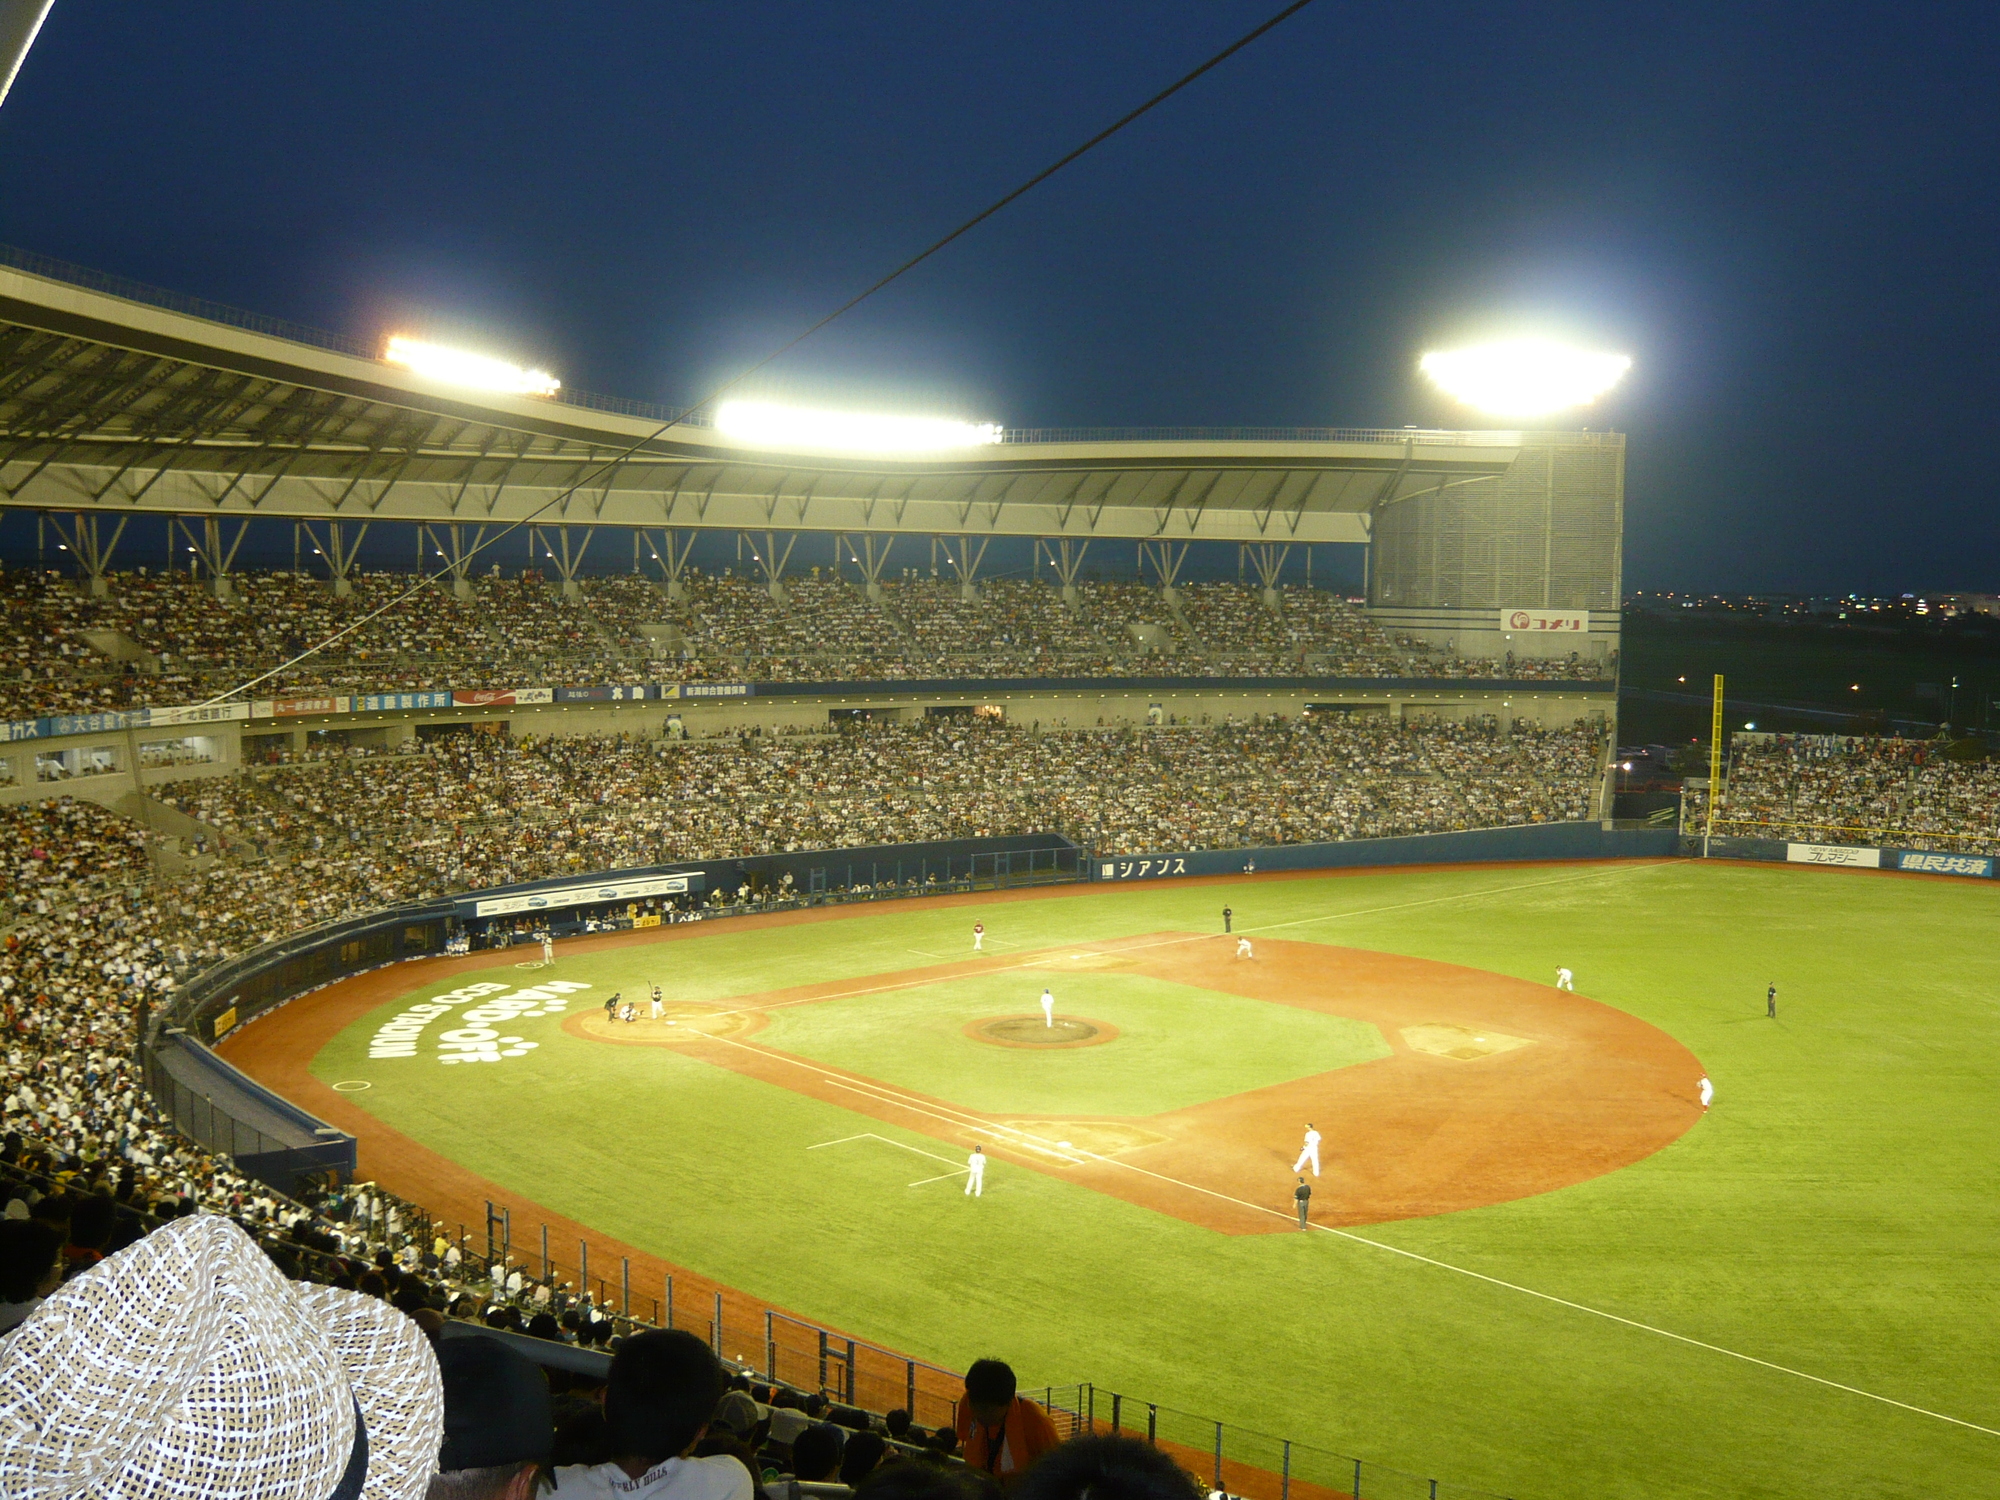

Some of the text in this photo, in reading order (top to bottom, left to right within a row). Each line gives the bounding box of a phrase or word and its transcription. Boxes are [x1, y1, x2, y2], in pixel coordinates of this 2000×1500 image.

[1532, 618, 1580, 630] コメリ
[1807, 851, 1858, 864] プレマシー
[1901, 854, 1988, 875] 県民共済
[1120, 858, 1186, 878] シアンス
[368, 1003, 454, 1059] STADIUM
[643, 1466, 668, 1487] HILLS
